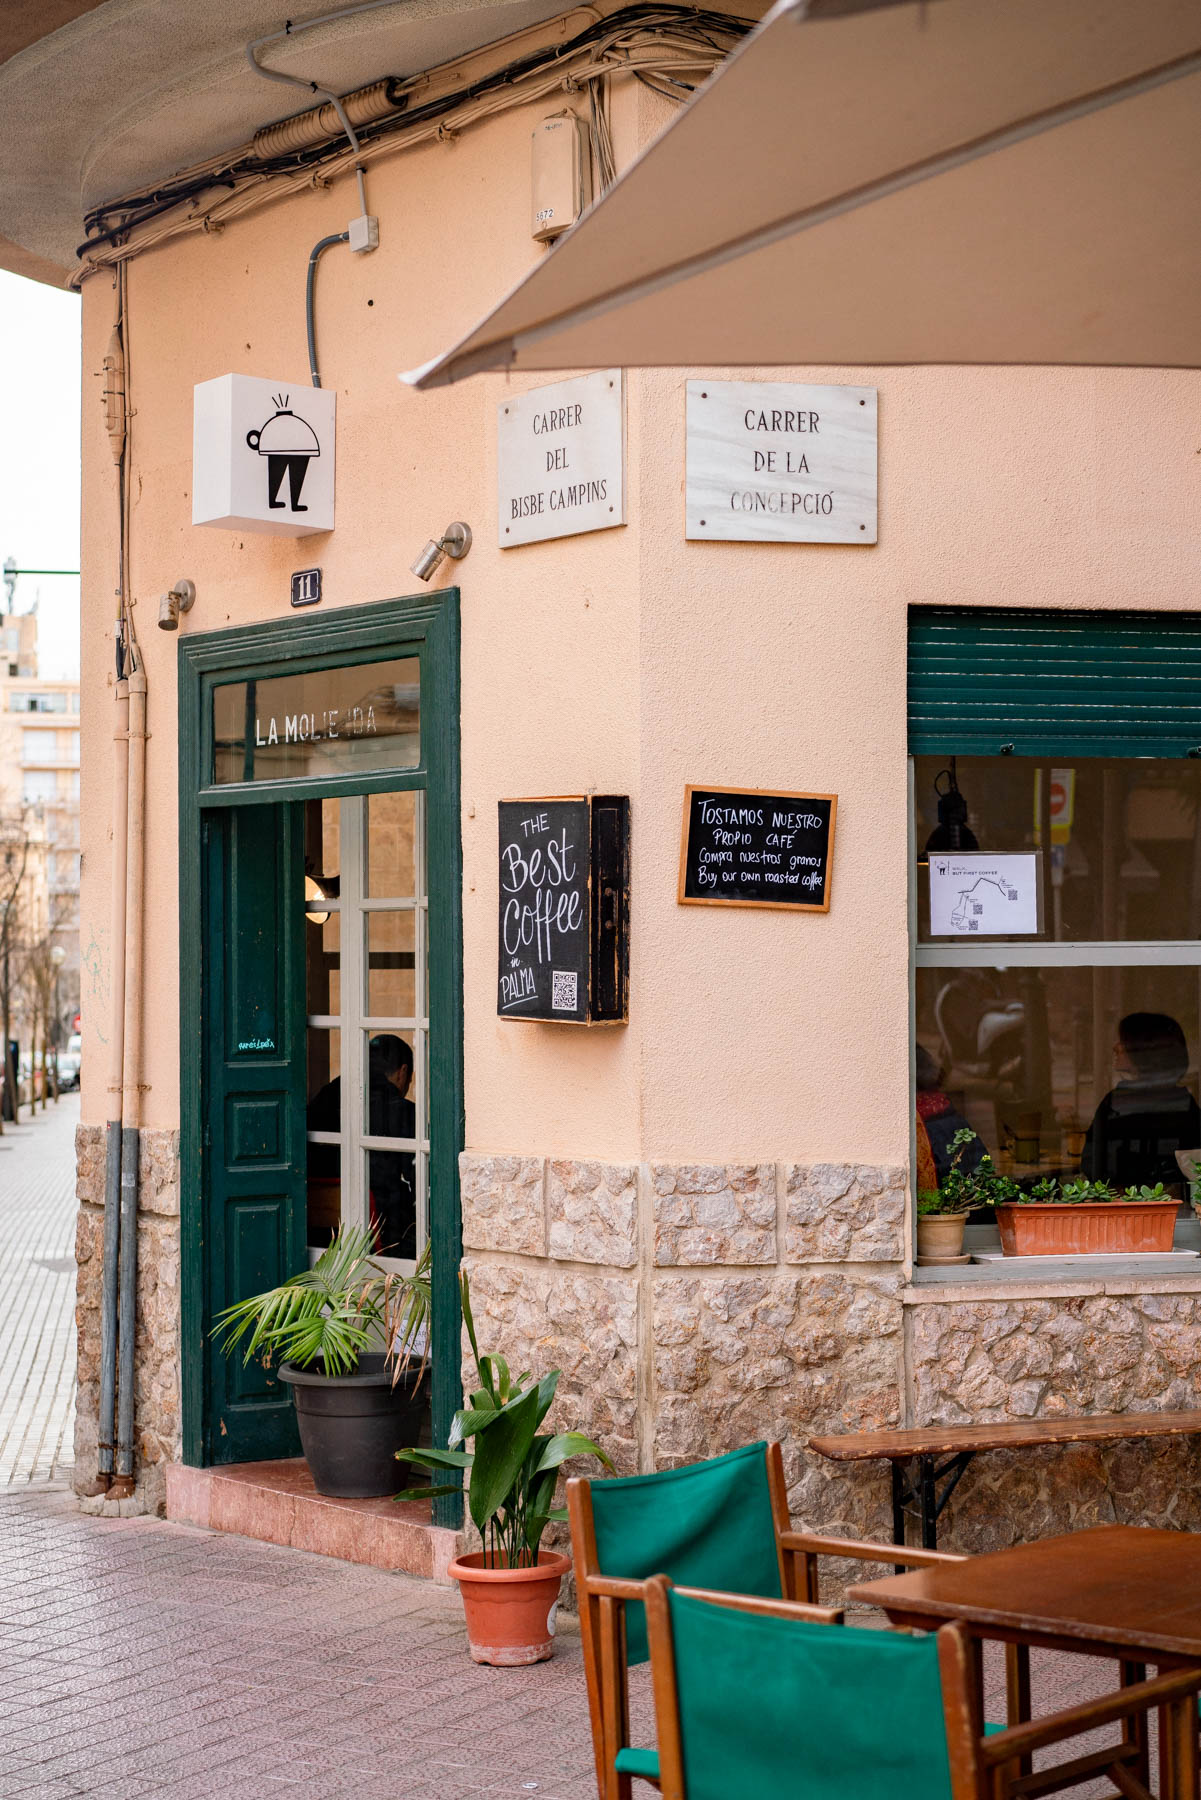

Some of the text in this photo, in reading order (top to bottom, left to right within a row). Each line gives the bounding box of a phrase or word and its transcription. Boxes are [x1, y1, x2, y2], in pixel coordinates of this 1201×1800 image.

[533, 404, 583, 435] CARRER
[744, 409, 820, 433] CARRER
[546, 447, 570, 472] DEL
[754, 450, 811, 474] DE LA
[511, 479, 608, 520] BISBE CAMPINS
[730, 490, 834, 516] CONCEPCIÓ
[298, 575, 312, 601] 11
[256, 717, 279, 746] LA
[520, 813, 550, 838] THE
[698, 799, 823, 829] TOSTAMOS NUESTRO
[712, 828, 798, 849] PROPIO CAFÉ
[698, 847, 822, 870] Compra nuestros granos
[698, 865, 717, 888] Buy
[722, 872, 736, 882] our
[765, 871, 800, 884] roasted
[801, 871, 823, 891] coffee
[503, 888, 583, 964] Coffee
[500, 967, 536, 1003] PALMA
